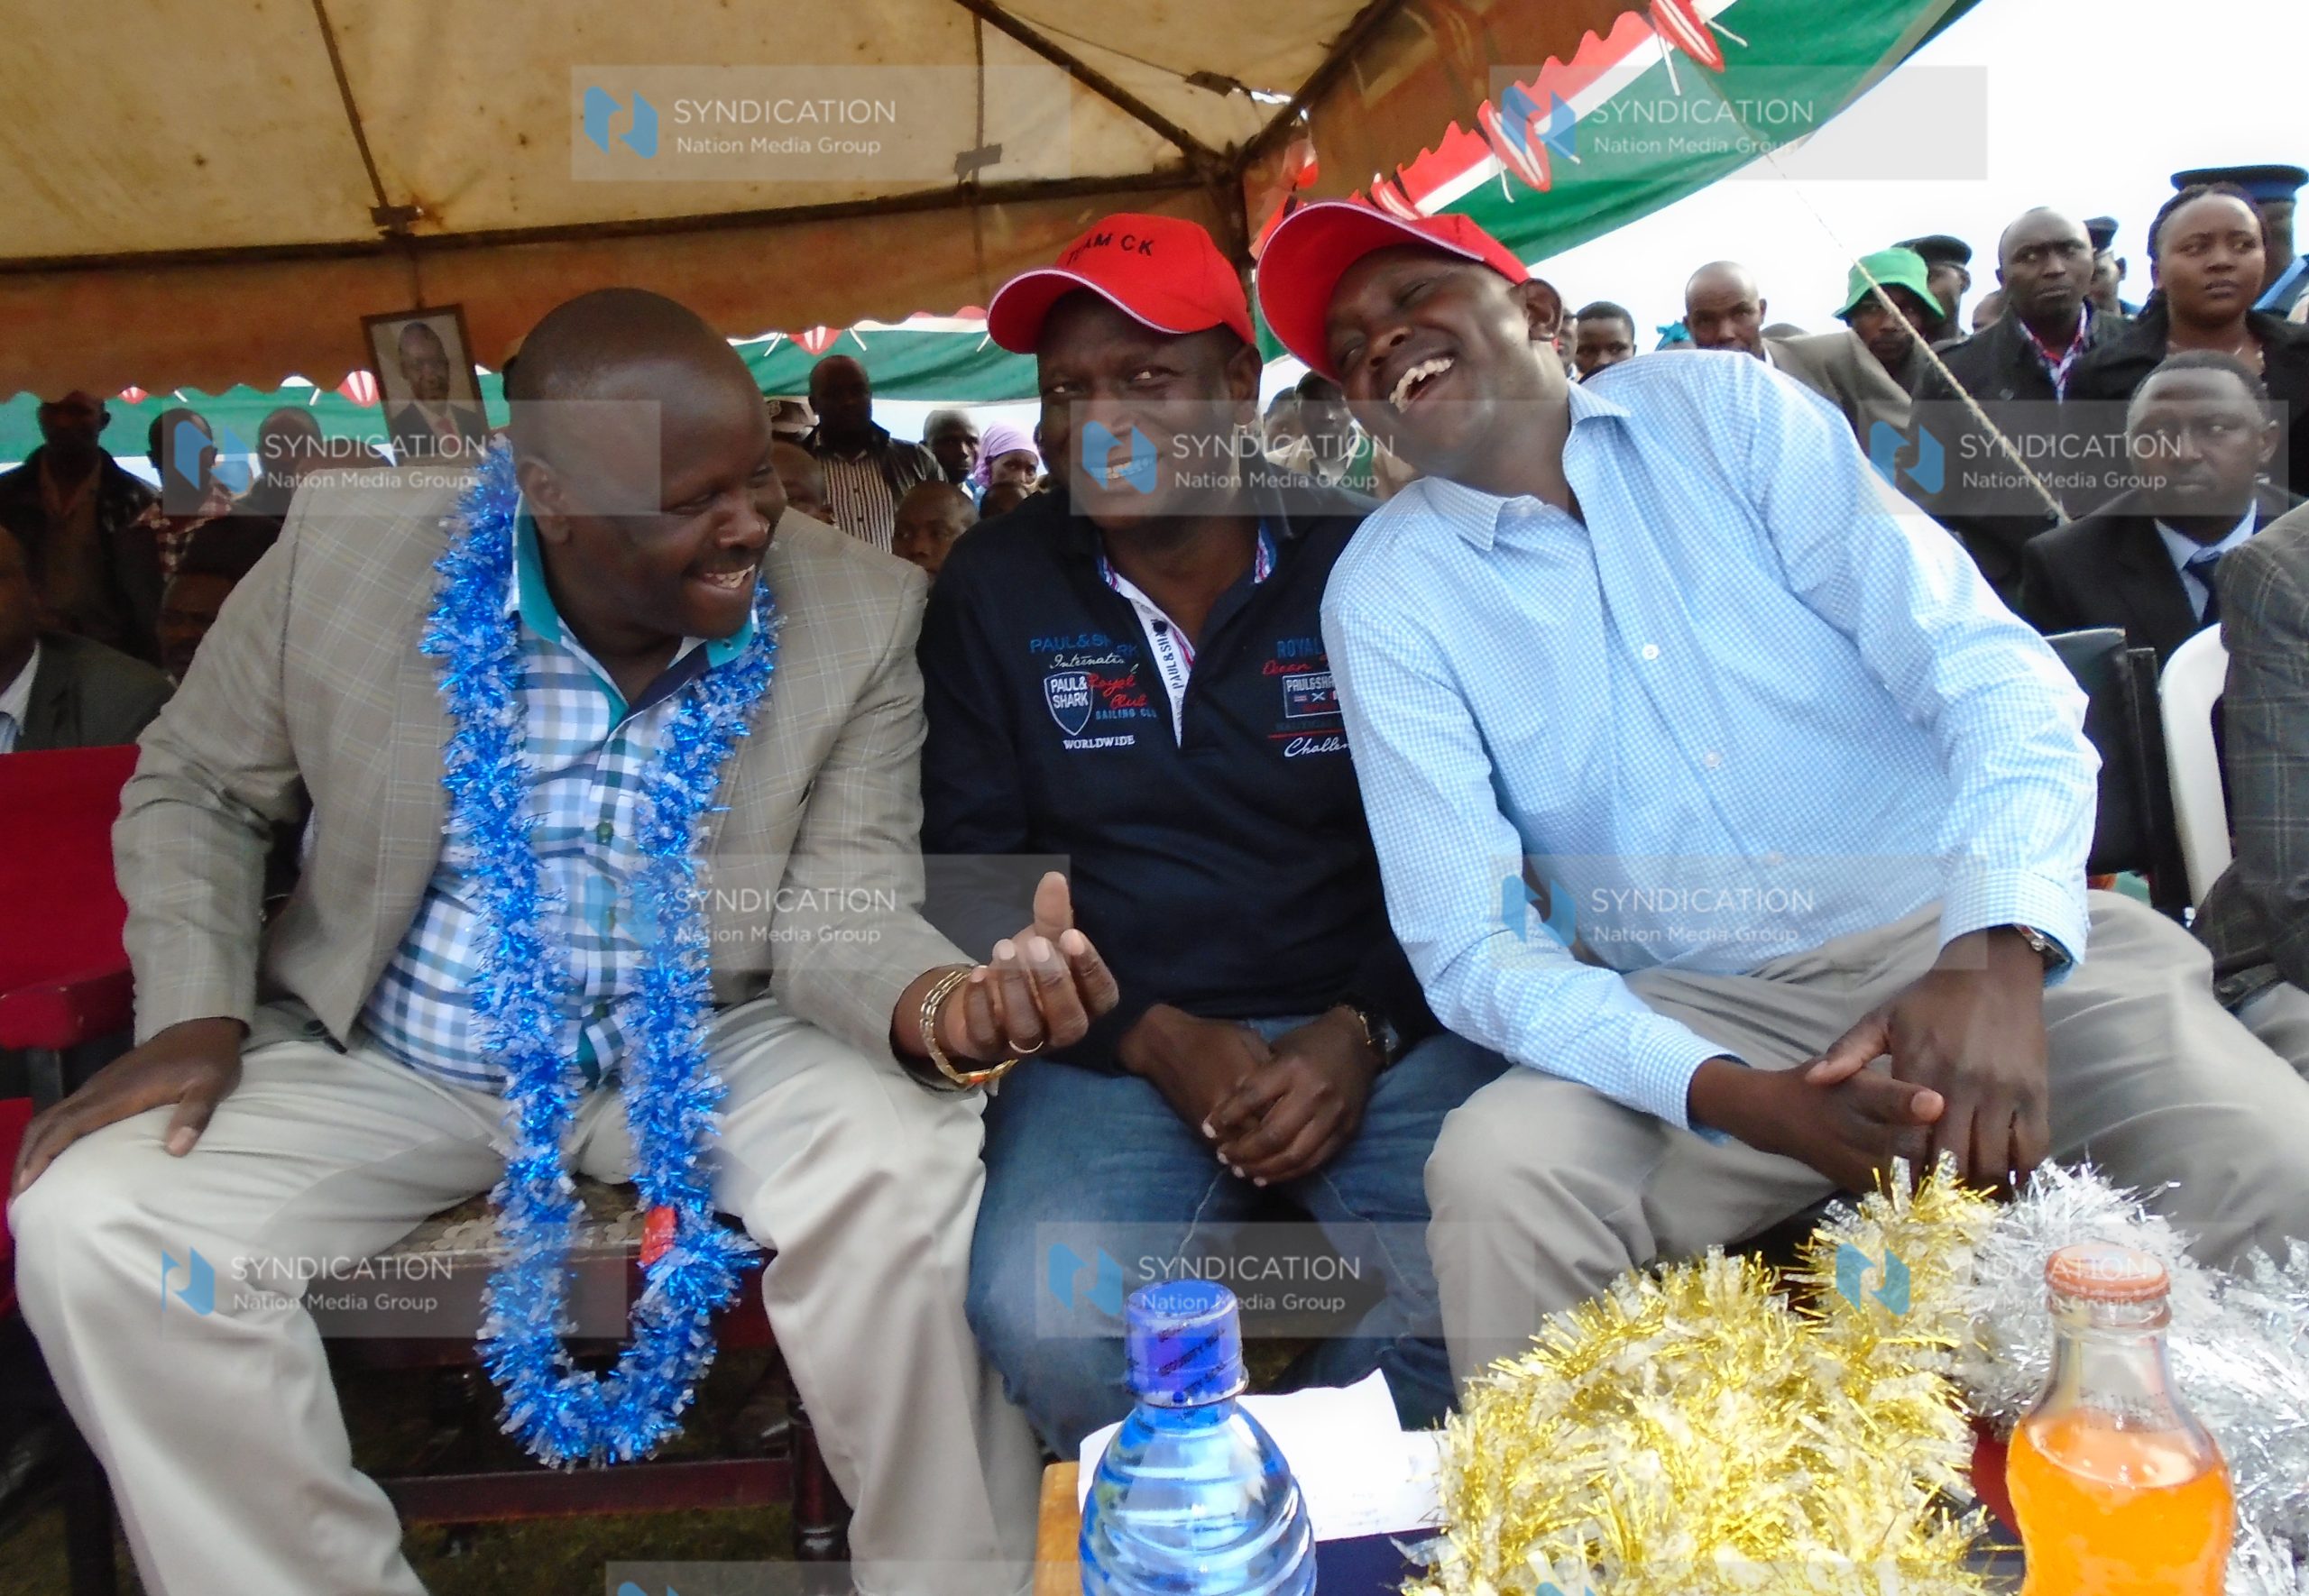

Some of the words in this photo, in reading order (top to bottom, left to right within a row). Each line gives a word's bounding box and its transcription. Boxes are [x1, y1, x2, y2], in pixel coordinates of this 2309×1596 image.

[1120, 234, 1154, 257] CK
[1276, 637, 1322, 658] ROYAL
[1051, 676, 1089, 693] PAUL&
[1286, 676, 1336, 693] PAUL&SHA
[1053, 692, 1089, 710] SHARK
[1095, 708, 1137, 721] SAILING
[1063, 734, 1136, 750] WORLDWIDE
[1283, 736, 1350, 758] Challen
